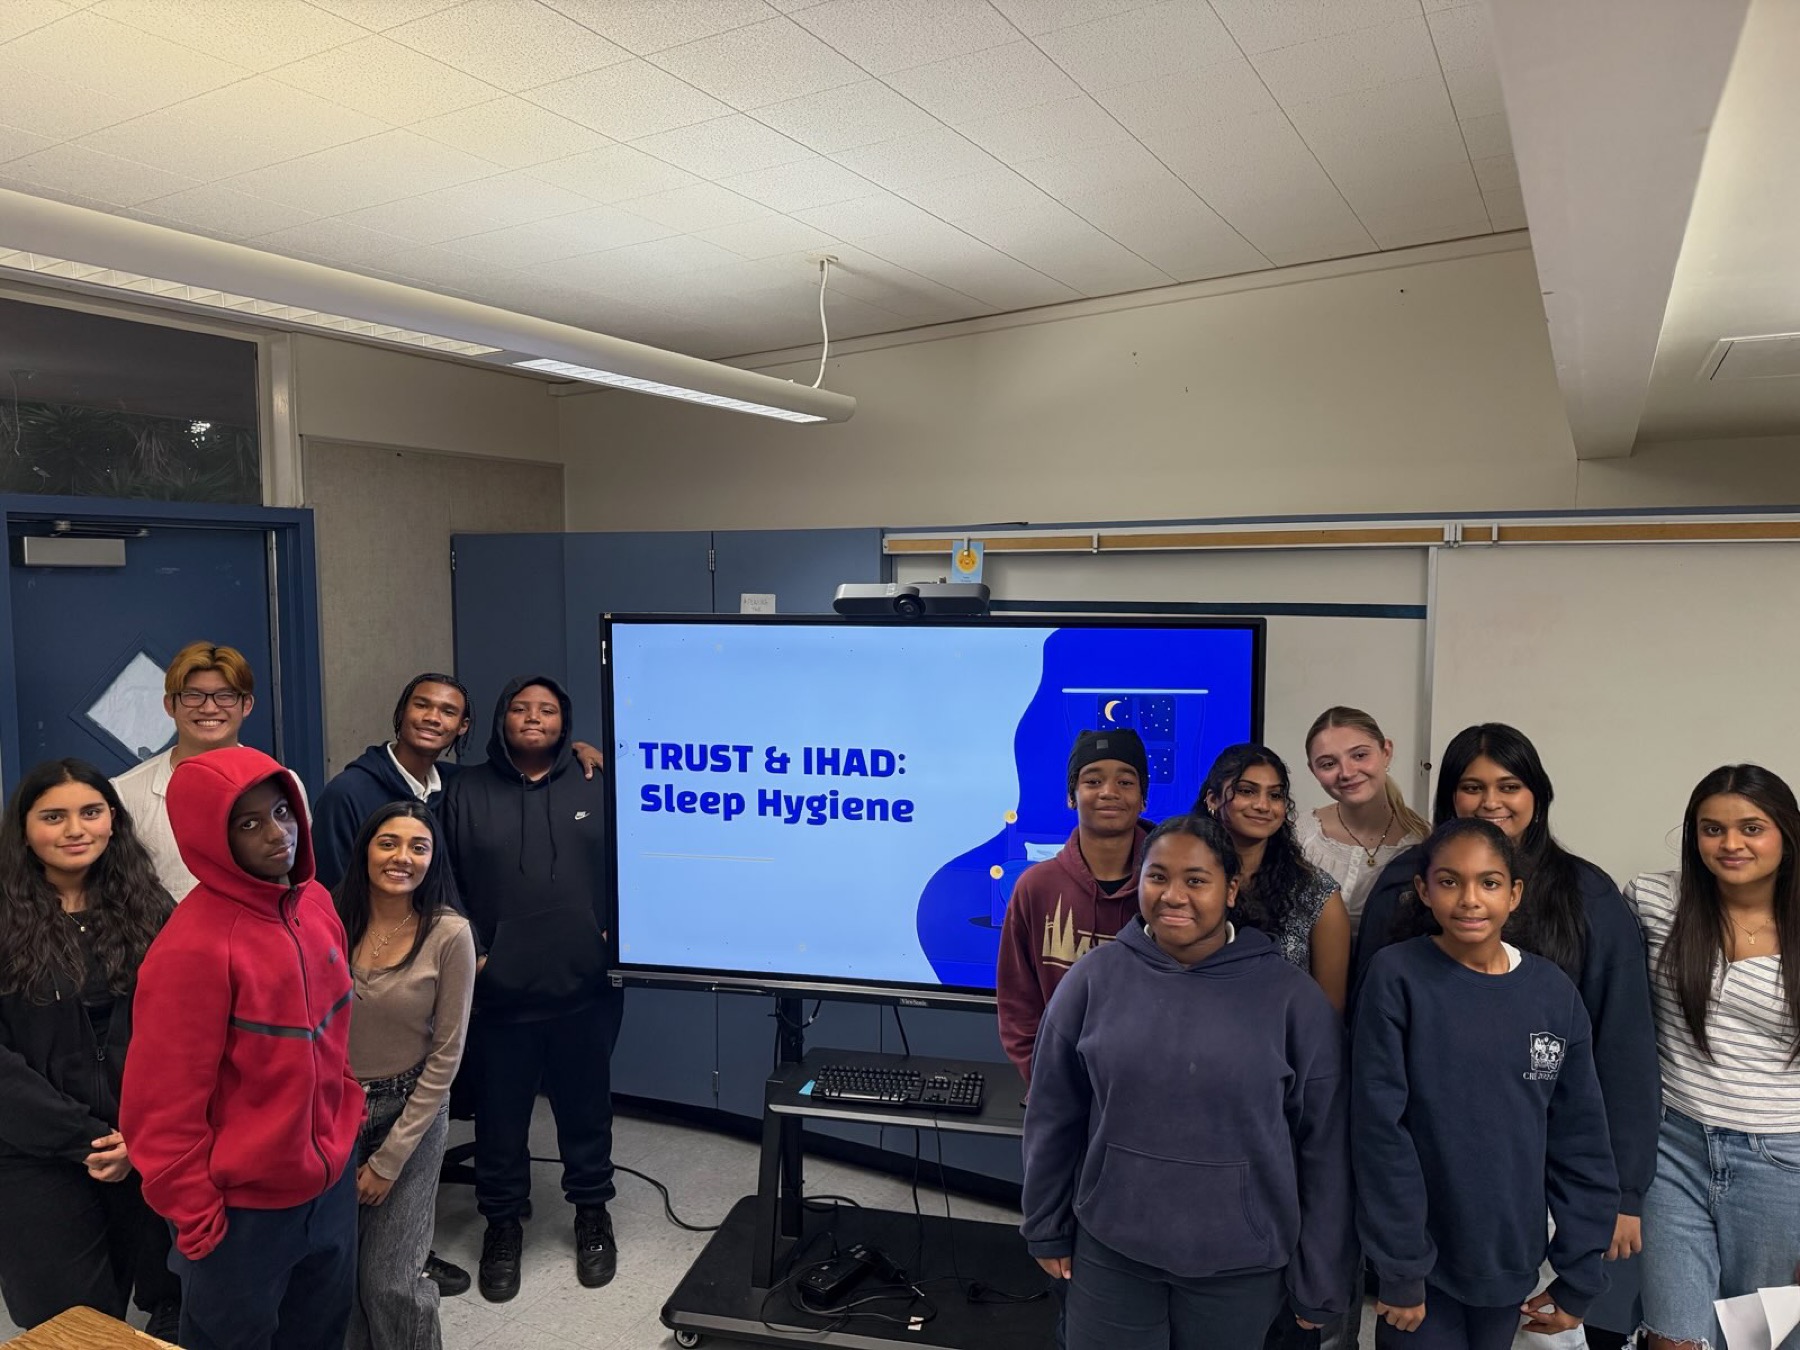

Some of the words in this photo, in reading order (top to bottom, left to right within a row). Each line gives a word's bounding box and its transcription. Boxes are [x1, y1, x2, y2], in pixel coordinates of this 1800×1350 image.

[639, 742, 753, 773] TRUST
[764, 746, 790, 774] &
[803, 747, 906, 777] IHAD:
[640, 784, 745, 821] Sleep
[757, 789, 914, 825] Hygiene
